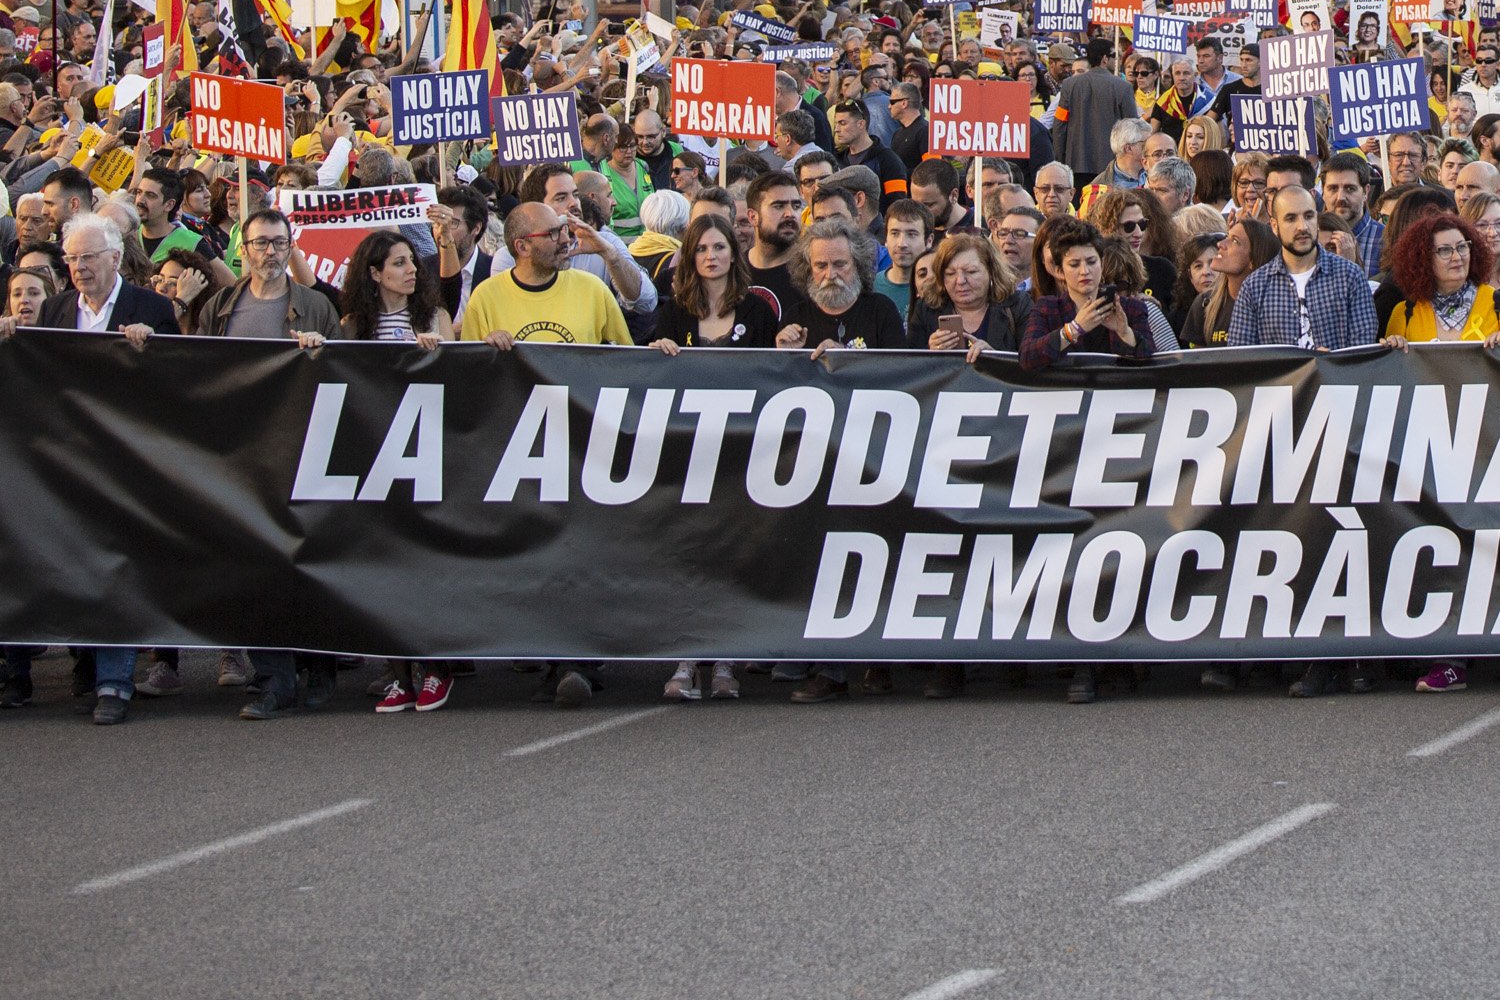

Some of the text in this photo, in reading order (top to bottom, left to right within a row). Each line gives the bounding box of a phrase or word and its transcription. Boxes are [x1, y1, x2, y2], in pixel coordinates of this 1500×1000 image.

[1038, 14, 1083, 31] JUSTÍCIA
[1297, 3, 1320, 11] Josep!
[734, 13, 796, 41] NO HAY JUSTÍCIA
[1139, 16, 1184, 38] NO HAY
[1187, 20, 1246, 34] RESOS
[763, 46, 833, 61] NO HAY JUSTÍCIA
[1136, 34, 1182, 52] JUSTÍCIA
[1267, 40, 1292, 70] NO
[1296, 35, 1329, 66] HAY
[194, 77, 220, 109] NO
[402, 73, 481, 111] NO HAY
[676, 63, 703, 94] NO
[1266, 66, 1329, 99] JUSTÍCIA
[1338, 62, 1418, 103] NO HAY
[501, 96, 570, 130] NO HAY
[934, 84, 962, 114] NO
[1241, 99, 1308, 125] NO HAY
[398, 107, 483, 140] JUSTÍCIA
[675, 97, 771, 136] PASARÁN
[1338, 98, 1422, 135] JUSTÍCIA
[196, 113, 282, 159] PASARÁN
[503, 126, 574, 163] JUSTÍCIA
[933, 114, 1026, 153] PASARÁN
[1239, 126, 1309, 151] JUSTÍCIA
[293, 187, 418, 212] LLIBERTAT
[294, 207, 421, 224] PRESOS POLÍTICS!
[292, 383, 445, 502] LA
